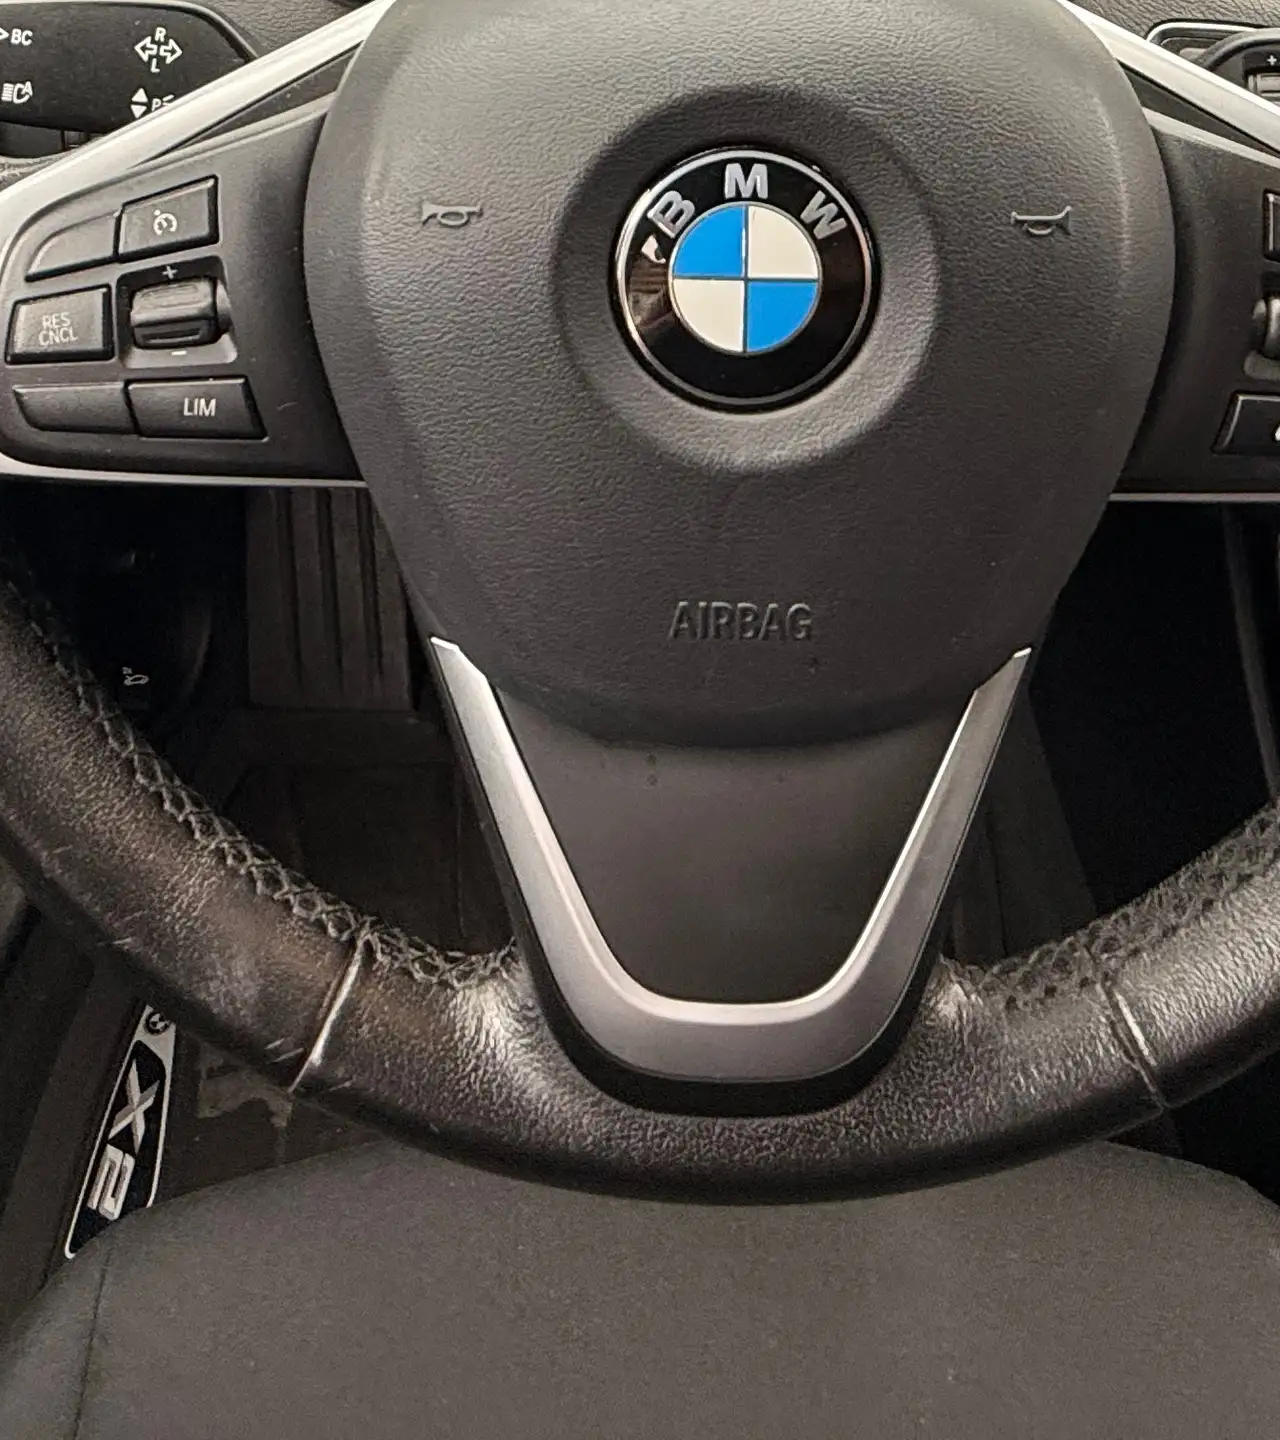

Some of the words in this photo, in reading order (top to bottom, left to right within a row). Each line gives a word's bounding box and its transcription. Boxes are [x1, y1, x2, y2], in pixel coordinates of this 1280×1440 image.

[10, 28, 33, 46] BC
[154, 27, 167, 42] R
[150, 57, 161, 73] L
[646, 162, 848, 241] BMW
[41, 311, 72, 329] RES
[38, 328, 79, 346] CNCL
[182, 397, 216, 417] LIM
[669, 600, 813, 641] AIRBAG
